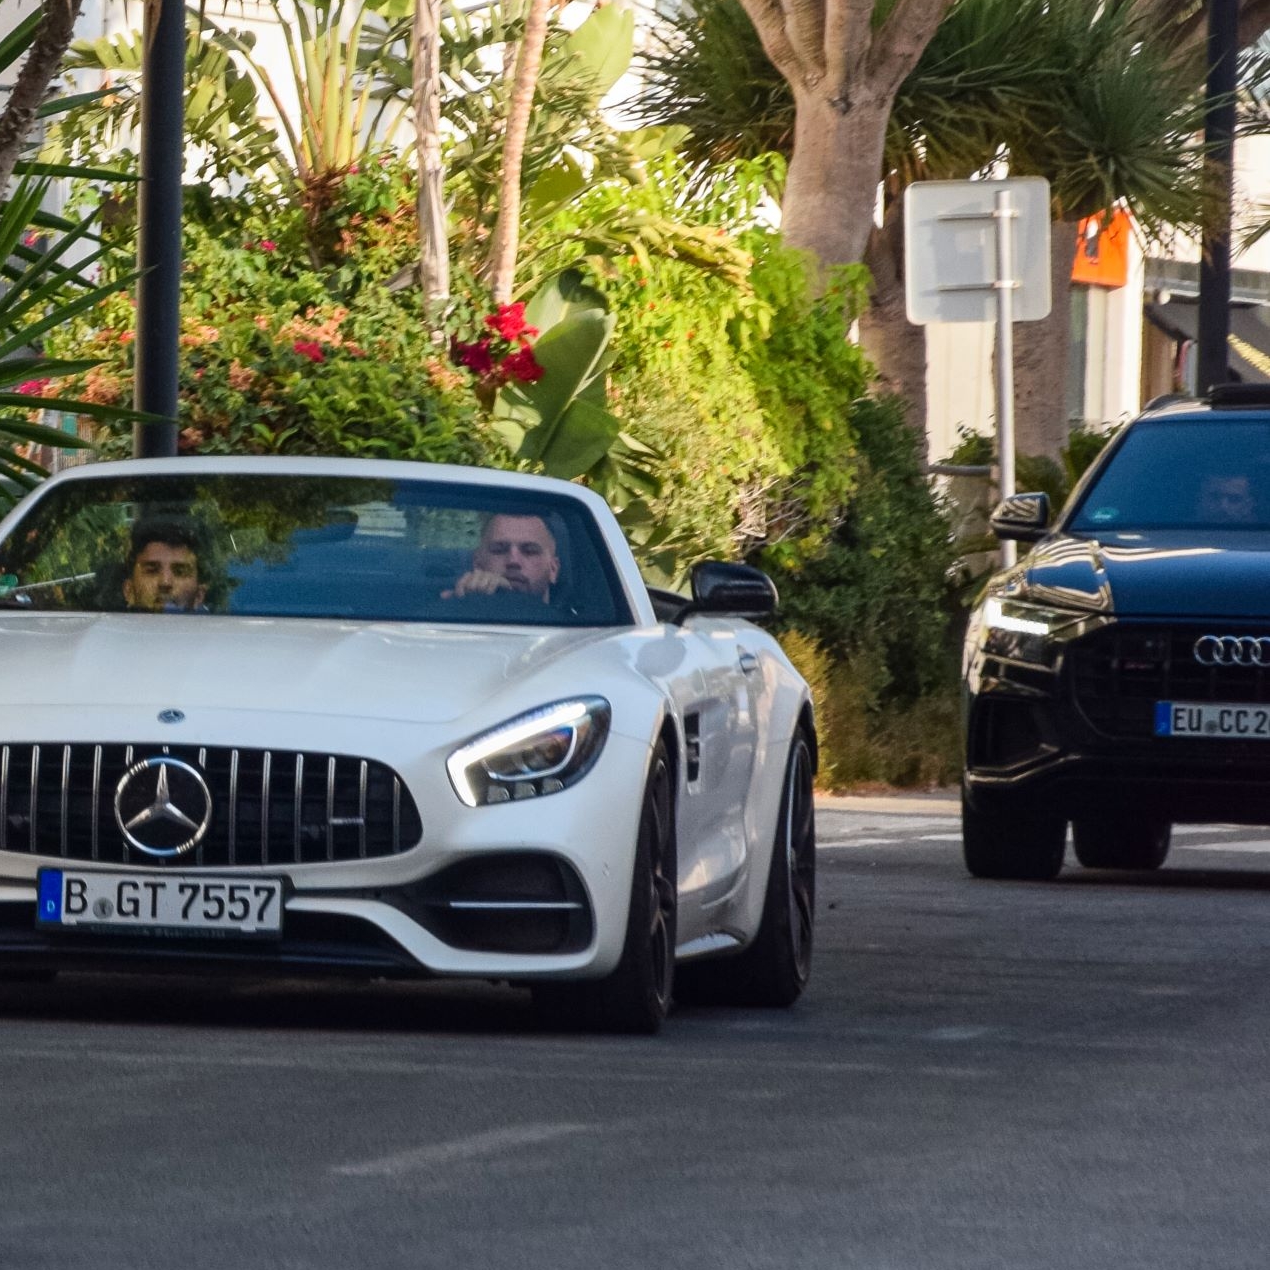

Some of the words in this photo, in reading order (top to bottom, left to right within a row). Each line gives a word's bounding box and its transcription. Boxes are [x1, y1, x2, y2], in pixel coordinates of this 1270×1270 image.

[1174, 708, 1202, 732] EU
[1219, 709, 1249, 734] CC
[1253, 710, 1270, 735] 2
[65, 879, 88, 915] B
[116, 881, 166, 918] GT
[179, 883, 276, 923] 7557
